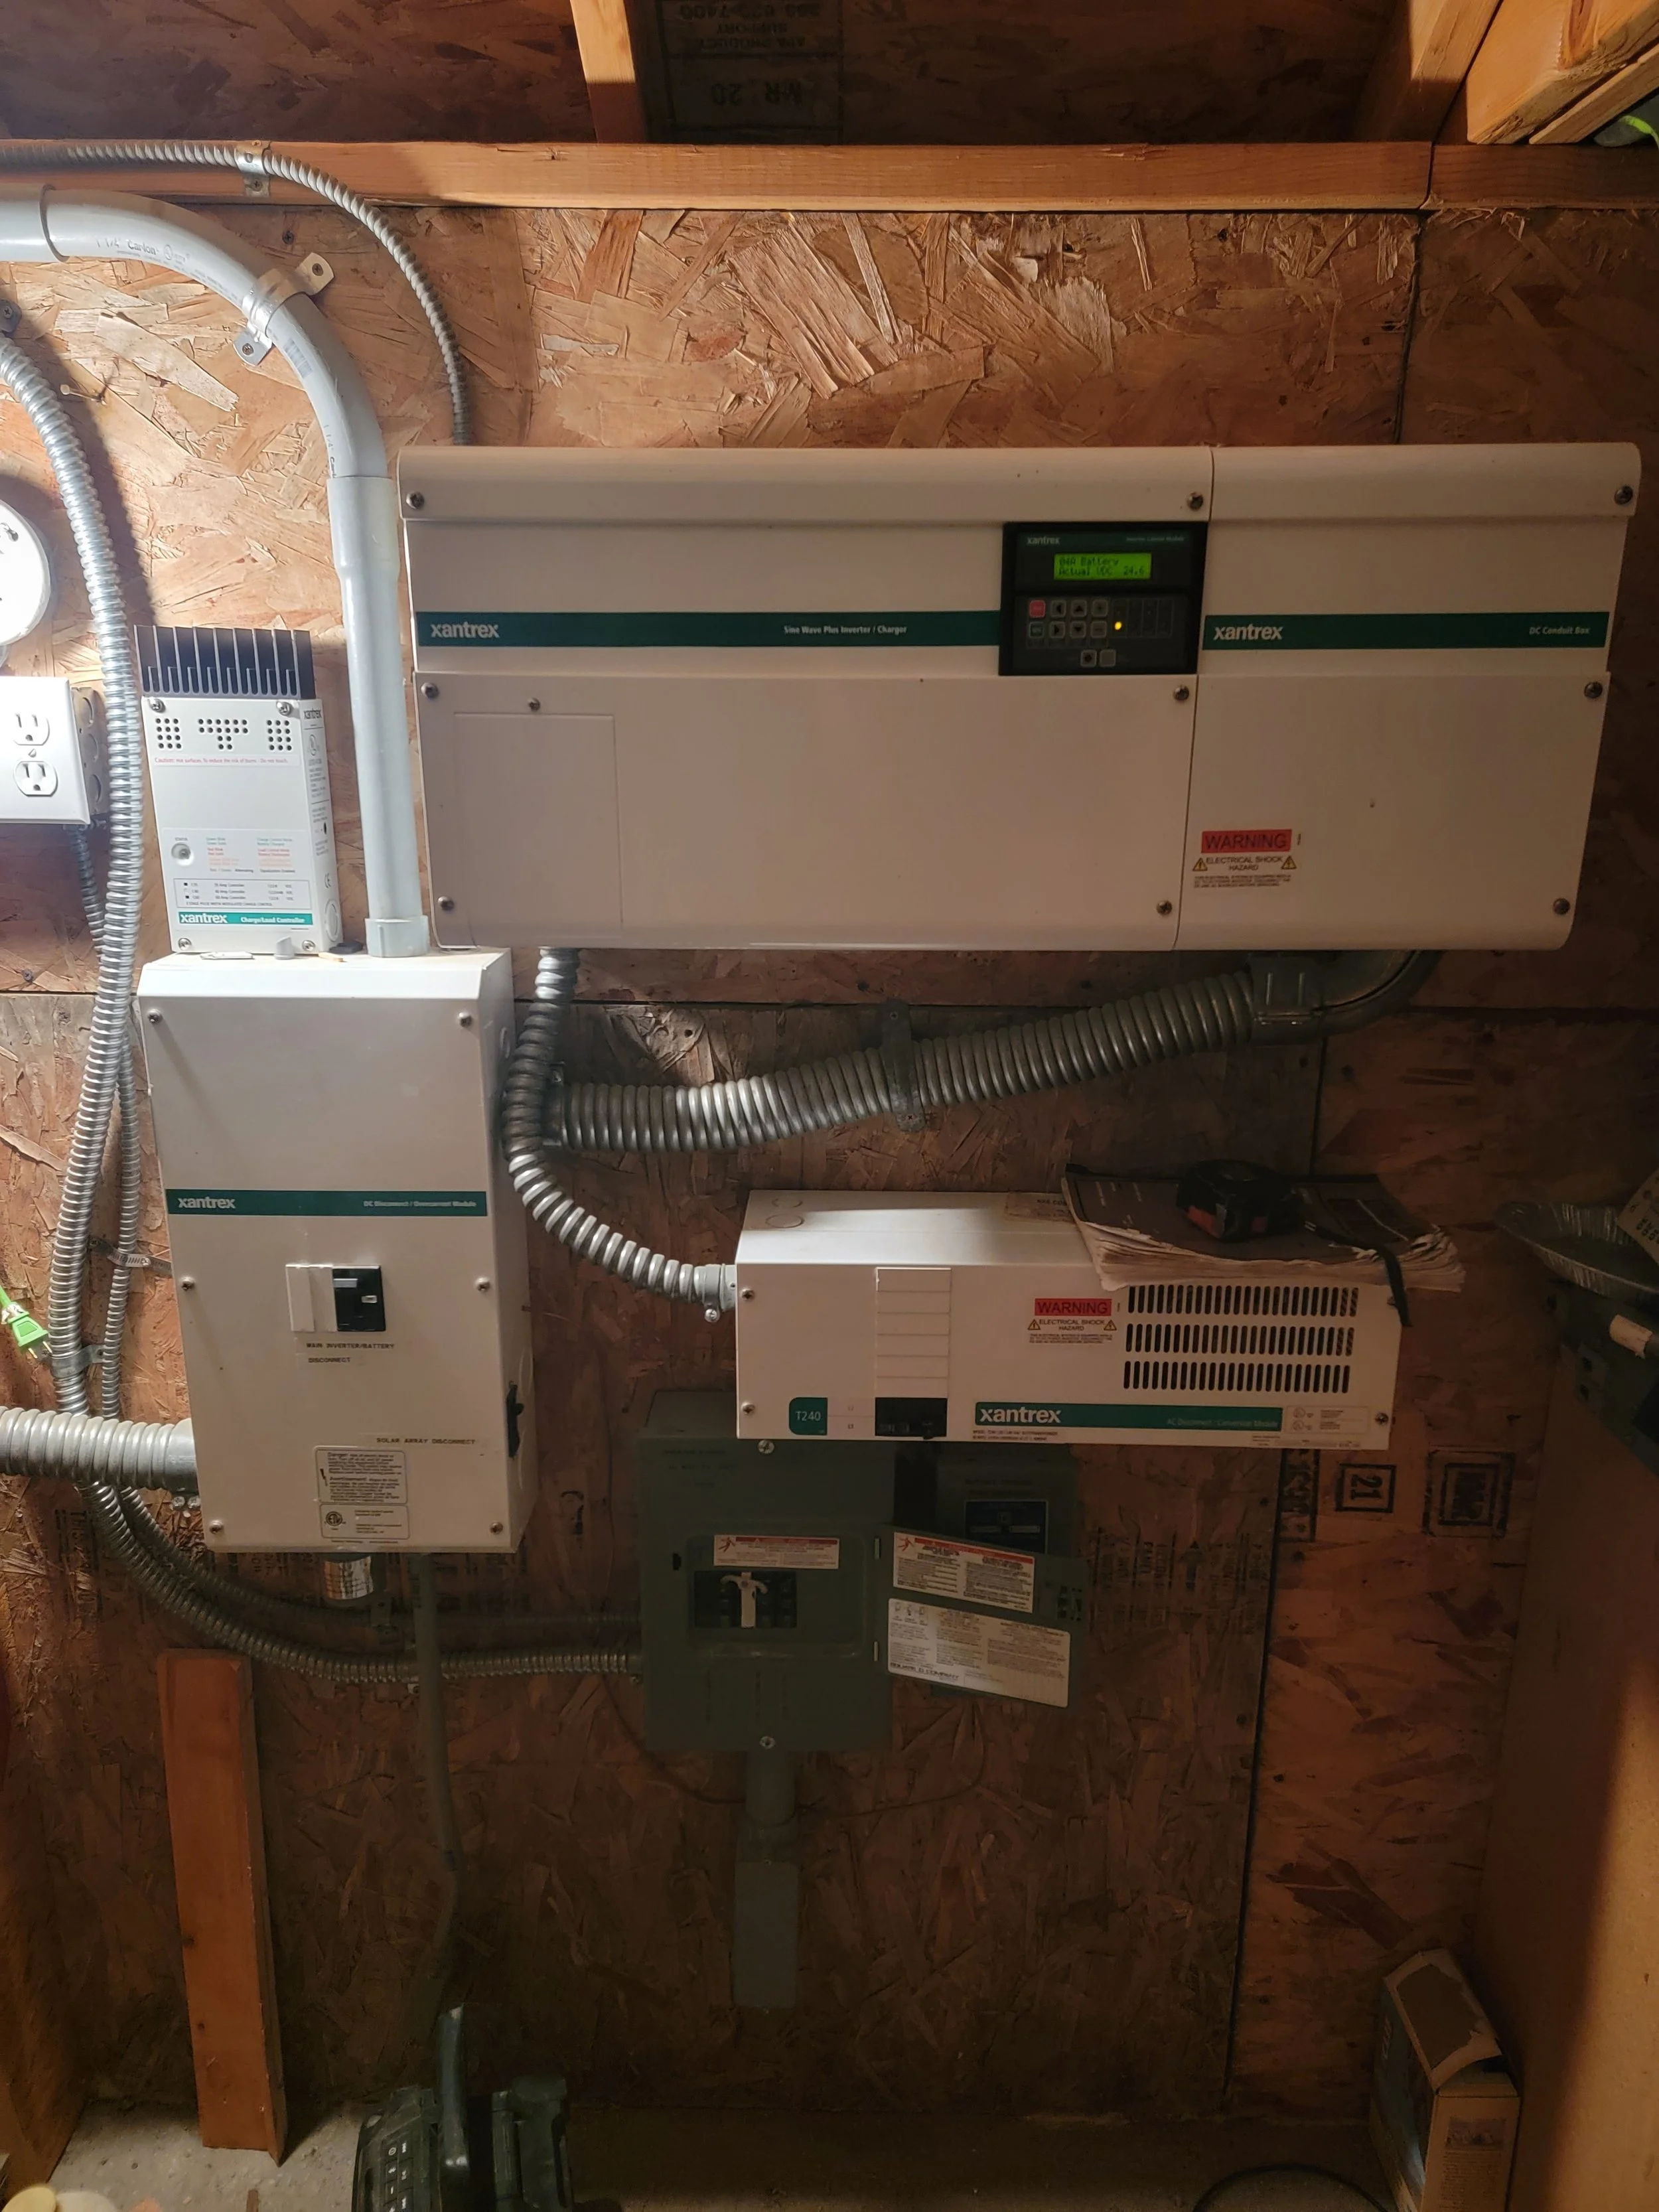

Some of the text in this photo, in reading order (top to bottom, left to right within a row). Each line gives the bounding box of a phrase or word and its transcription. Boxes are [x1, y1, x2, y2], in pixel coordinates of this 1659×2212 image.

[1027, 536, 1060, 546] xantrex
[1080, 556, 1119, 567] Battery
[1058, 566, 1090, 576] Actual
[430, 621, 500, 640] xantrex
[784, 625, 800, 634] Sine
[801, 625, 822, 634] Wave
[823, 625, 839, 634] Plus
[840, 625, 871, 634] Inverter
[877, 625, 907, 636] Charger
[1214, 623, 1590, 641] xantrex DC Conduit Box
[1205, 833, 1287, 849] WARNING
[180, 913, 228, 924] xantrex
[177, 1195, 236, 1211] xantrex
[1037, 1301, 1108, 1314] WARNING
[795, 1410, 821, 1422] T240
[979, 1405, 1061, 1424] xantrex
[1350, 1473, 1383, 1501] 21
